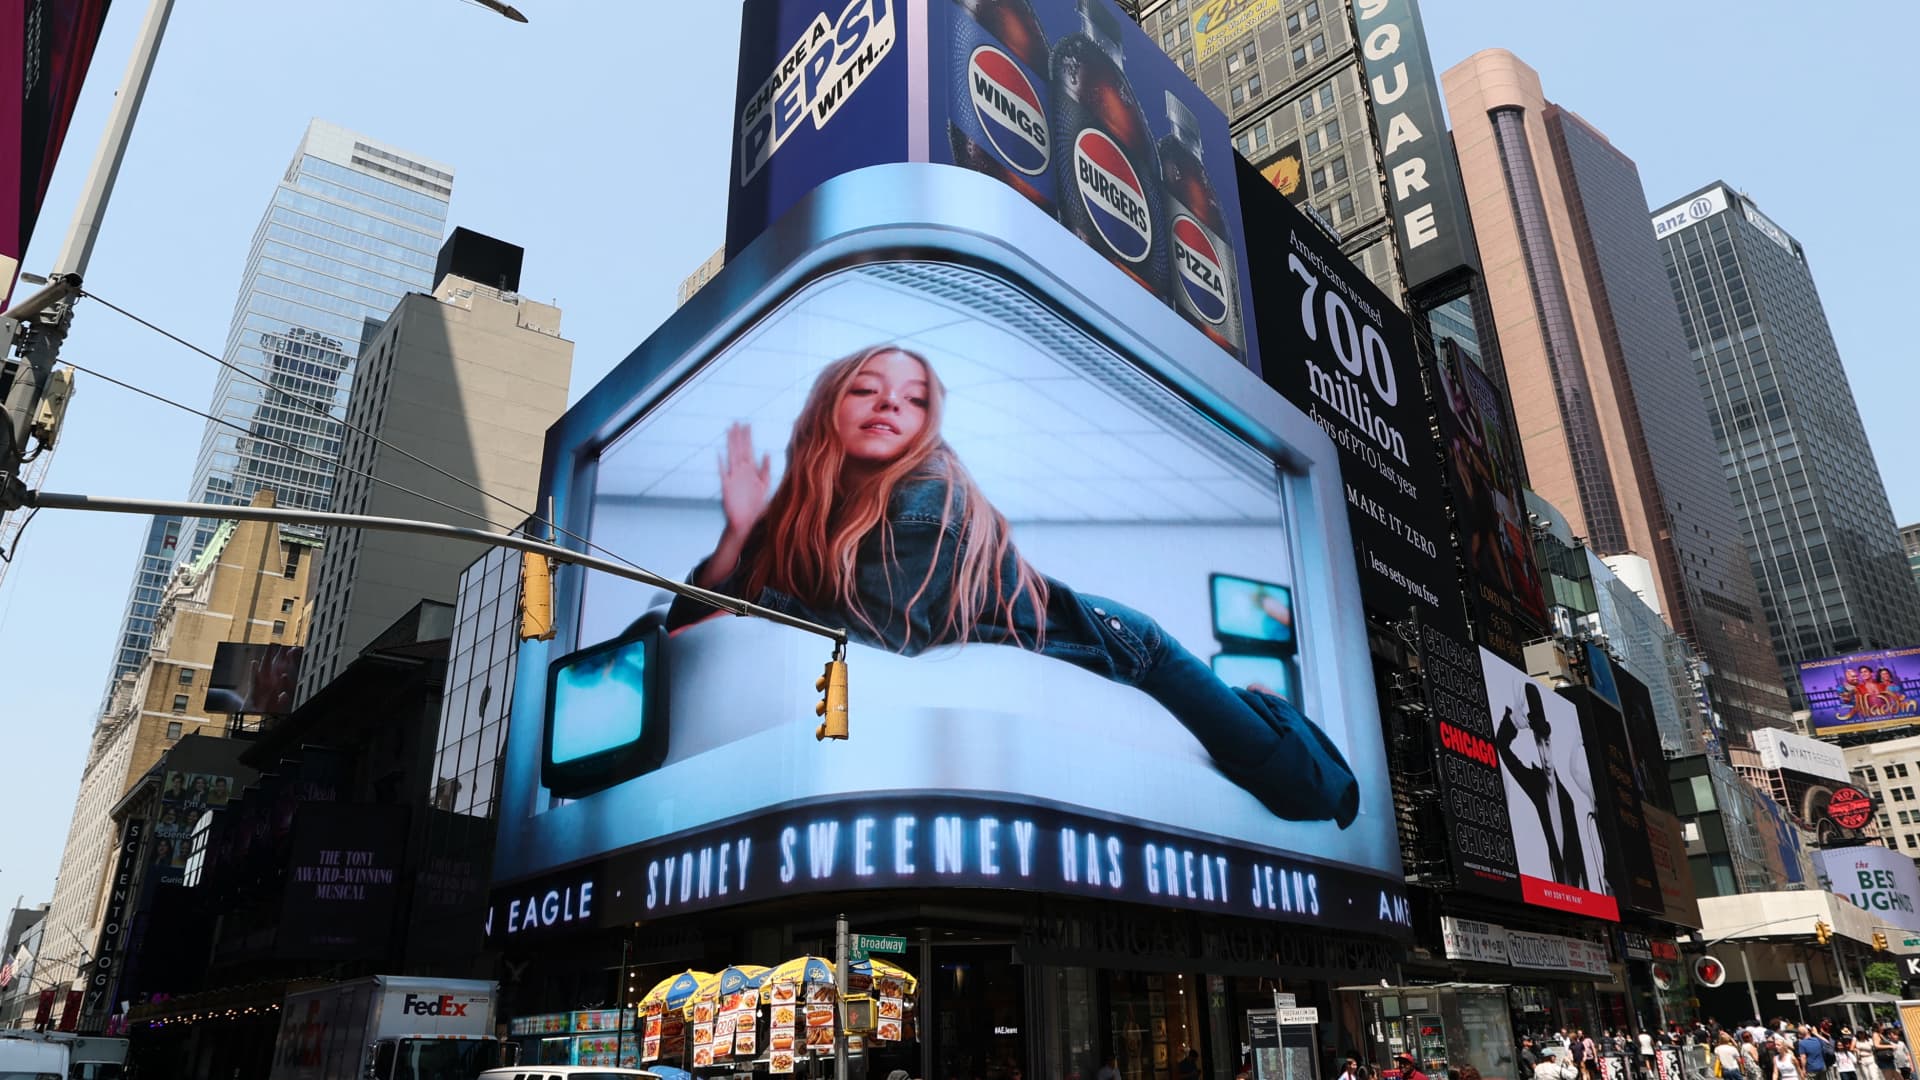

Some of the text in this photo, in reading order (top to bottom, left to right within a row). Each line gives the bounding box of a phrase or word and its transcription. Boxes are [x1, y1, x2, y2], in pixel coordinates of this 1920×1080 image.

[745, 22, 826, 127] SHARE A
[974, 71, 1047, 148] WINGS
[1078, 154, 1147, 233] BURGERS
[1173, 239, 1225, 298] PIZZA
[1289, 229, 1383, 328] Americans wasted
[1288, 252, 1398, 407] 700
[1305, 359, 1410, 467] million
[1309, 402, 1417, 500] days of PTO last year
[1346, 483, 1437, 559] MAKE IT ZERO
[1370, 550, 1439, 608] less sets you free
[1423, 624, 1481, 678] CHICAGO
[1428, 655, 1487, 708] CHICAGO
[1835, 691, 1917, 720] Aladdin
[1433, 688, 1491, 739] CHICAGO
[1440, 721, 1498, 769] CHICAGO
[1790, 749, 1812, 760] HYATT
[1444, 753, 1503, 801] CHICAGO
[1450, 788, 1508, 832] CHICAGO
[319, 850, 374, 866] THE TONY
[646, 816, 1319, 916] SYDNEY SWEENEY HAS GREAT JEANS
[1456, 822, 1515, 866] CHICAGO
[1855, 860, 1869, 869] the
[295, 866, 393, 884] AWARD-WINNING
[316, 884, 366, 900] MUSICAL
[86, 825, 139, 1016] SCIENTOLOGY
[508, 881, 594, 934] EAGLE
[860, 937, 903, 953] Broadway
[403, 994, 469, 1016] FedEx
